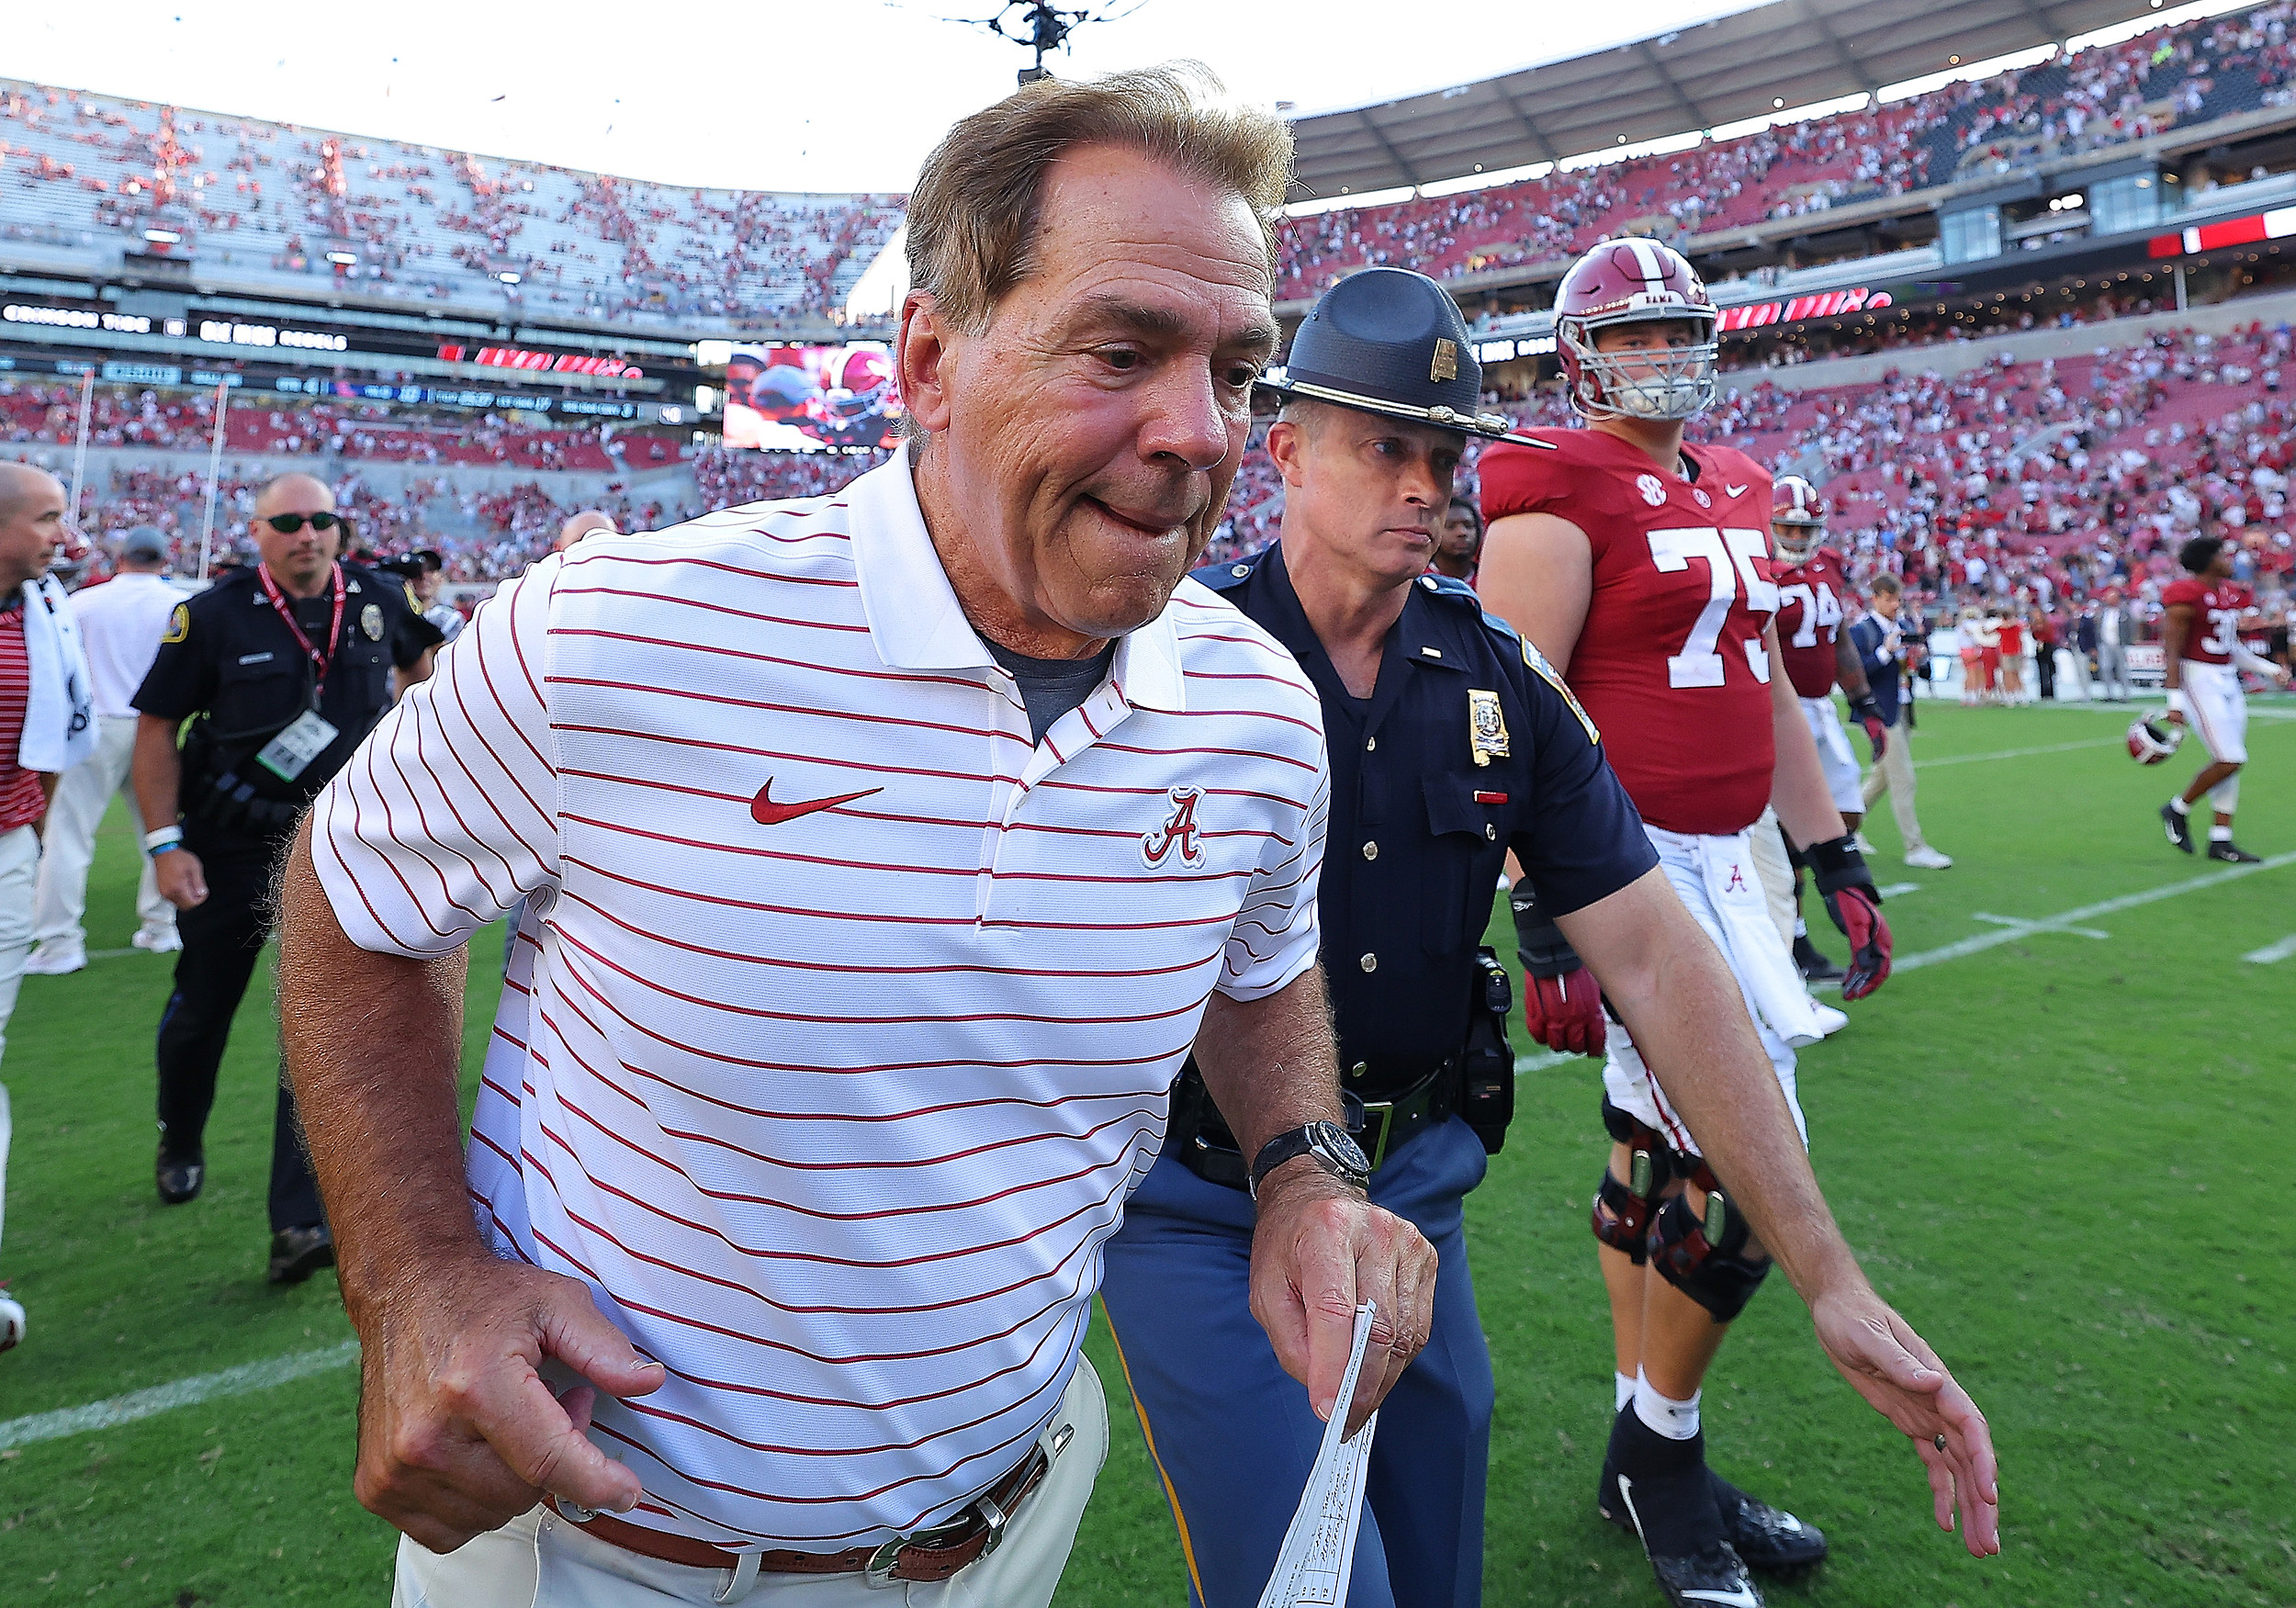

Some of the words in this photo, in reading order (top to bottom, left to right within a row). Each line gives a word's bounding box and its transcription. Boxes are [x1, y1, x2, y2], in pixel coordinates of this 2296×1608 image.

[1646, 526, 1779, 689] 75
[1780, 581, 1844, 648] 74
[1144, 793, 1199, 861] A
[1725, 864, 1748, 893] A
[1322, 1588, 1329, 1598] 12
